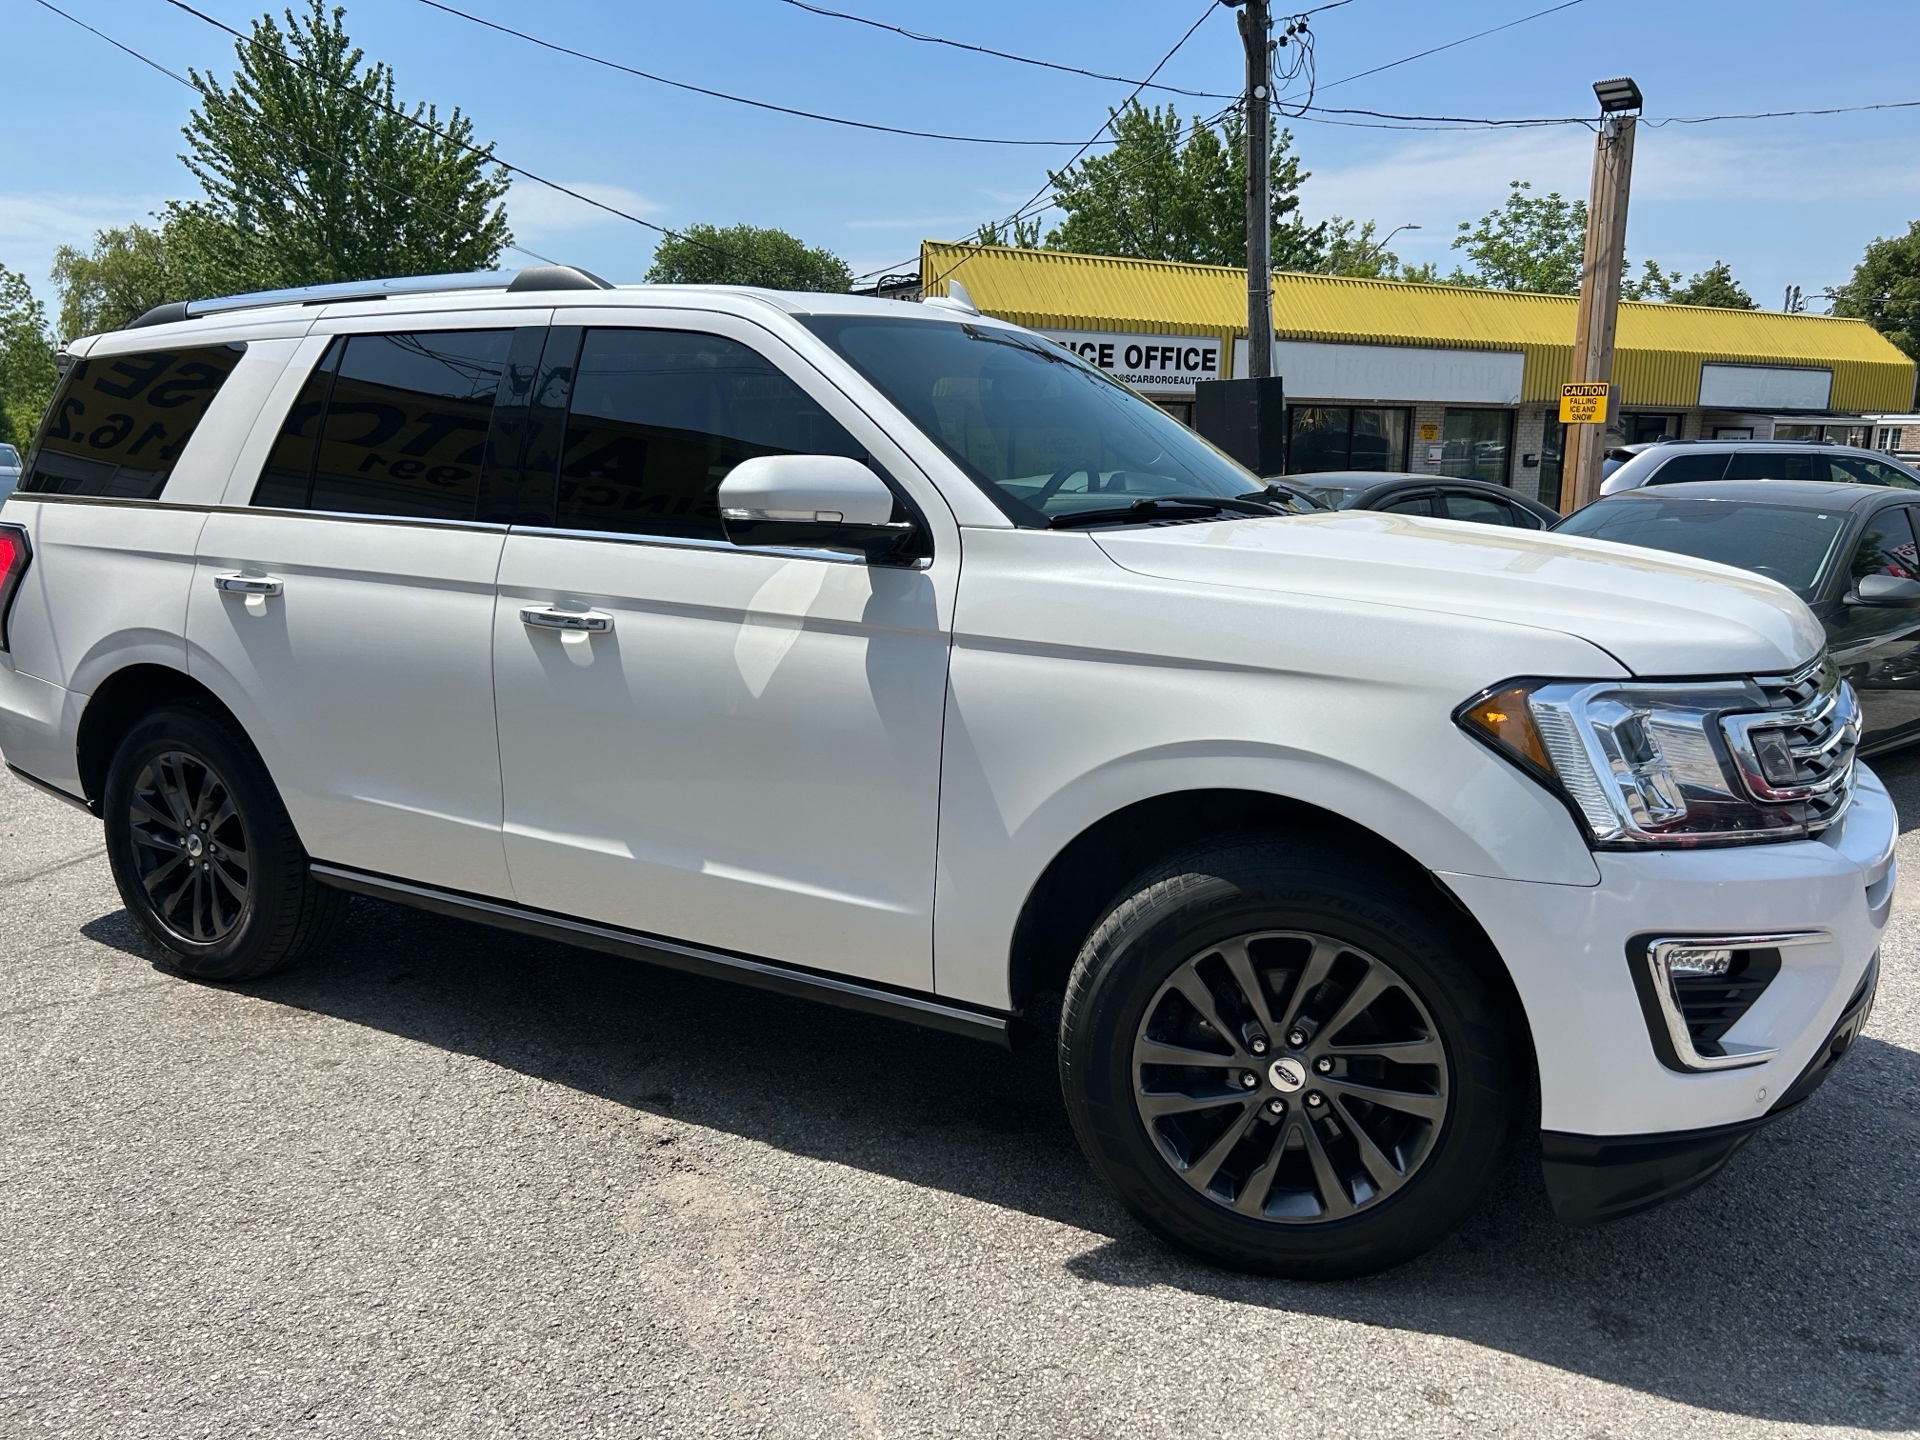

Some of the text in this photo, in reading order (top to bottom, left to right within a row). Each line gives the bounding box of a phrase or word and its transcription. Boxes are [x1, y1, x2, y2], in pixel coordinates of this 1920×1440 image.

[1124, 345, 1216, 371] OFFICE
[1112, 374, 1216, 385] @SCARBOROEAUT
[1564, 386, 1605, 396] CAUTION
